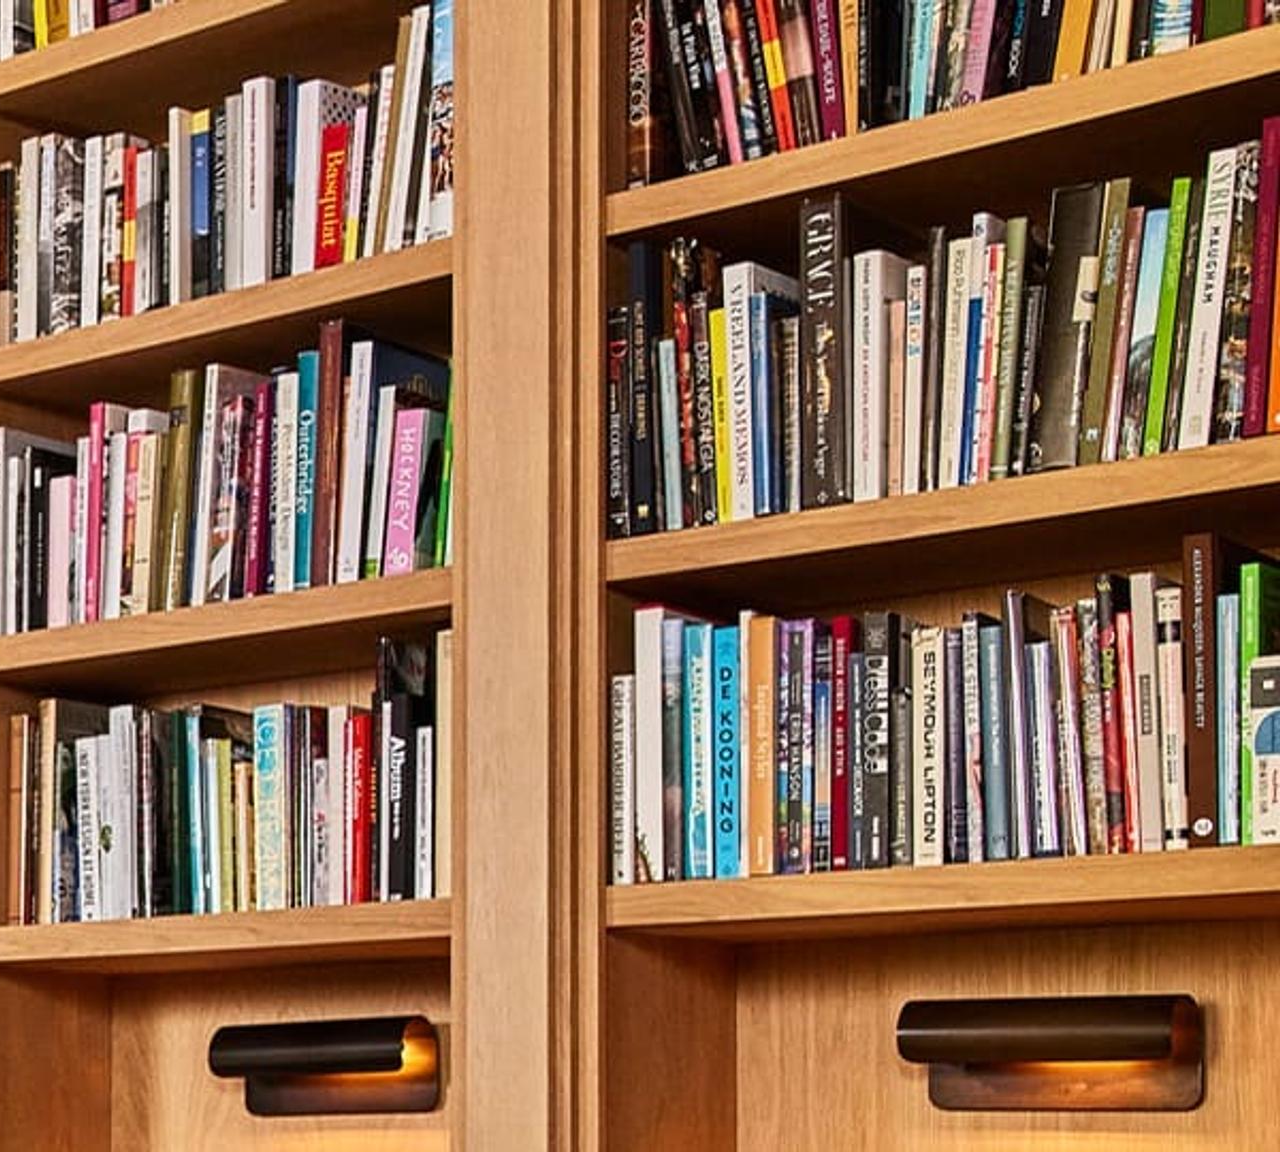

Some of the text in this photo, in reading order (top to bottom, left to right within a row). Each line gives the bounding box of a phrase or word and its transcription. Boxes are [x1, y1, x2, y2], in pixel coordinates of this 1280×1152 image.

[319, 149, 346, 250] Basquiat
[1202, 161, 1234, 304] SYRIE MAUGHAM
[807, 211, 836, 313] GRACE
[695, 341, 714, 474] DARK NOSTALGIA
[728, 283, 749, 487] VREELAND MEMOS
[297, 410, 315, 514] Outerbridge
[392, 427, 417, 531] HOCKNEY
[611, 413, 623, 499] DECORATORS
[1193, 549, 1204, 604] ALEXANDER
[612, 680, 626, 735] GREAT
[720, 666, 734, 834] DE KOONING
[865, 654, 888, 775] Dress Code
[924, 651, 936, 844] SEYMOUR LIPTON
[966, 676, 978, 726] STELLA
[1196, 692, 1205, 728] BEAUTY
[389, 735, 407, 804] Album
[790, 712, 802, 802] ERIN HANSON
